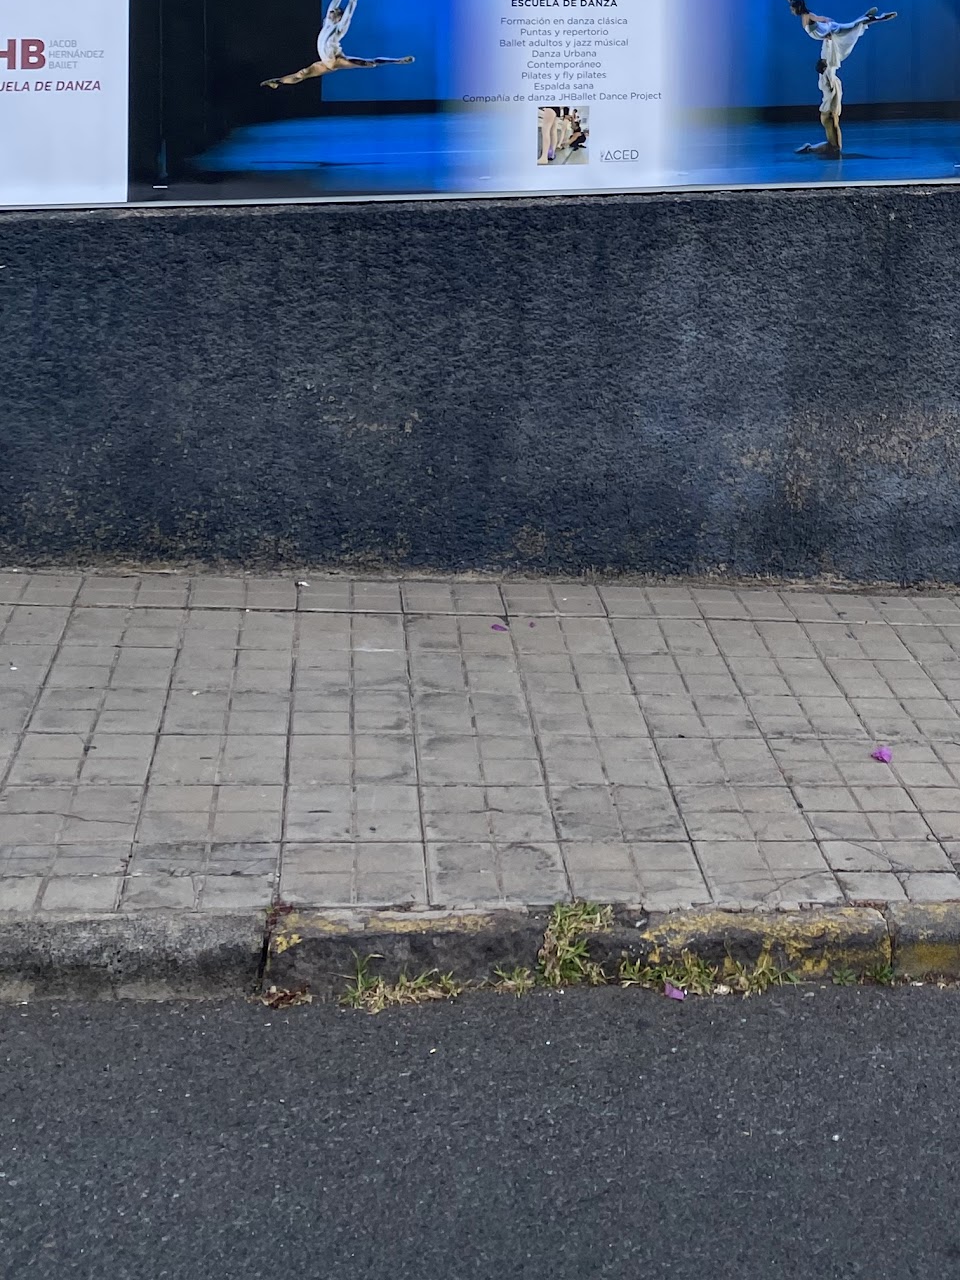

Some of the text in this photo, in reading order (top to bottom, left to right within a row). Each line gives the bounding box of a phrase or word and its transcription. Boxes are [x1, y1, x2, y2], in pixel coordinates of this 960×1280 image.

[511, 0, 618, 8] ESCUELA DE DANZA
[500, 17, 550, 26] Formación
[567, 17, 595, 25] danza
[597, 17, 628, 25] clásica
[520, 28, 609, 38] Puntas y repertorio
[48, 39, 77, 48] JACOB
[500, 39, 526, 48] Ballet
[528, 39, 563, 48] adultos
[573, 39, 592, 48] jazz
[0, 39, 45, 69] HB
[48, 49, 105, 59] HERNÁNDEZ
[531, 50, 597, 58] Danza Urbana
[527, 60, 602, 70] Contemporáneo
[521, 71, 552, 80] Pilates
[562, 71, 575, 80] fly
[576, 70, 607, 80] pilates
[34, 81, 53, 91] DE
[55, 80, 101, 91] DANZA
[534, 82, 571, 92] Espalda
[462, 91, 662, 104] Compañía de danza JHBallet Dance Project
